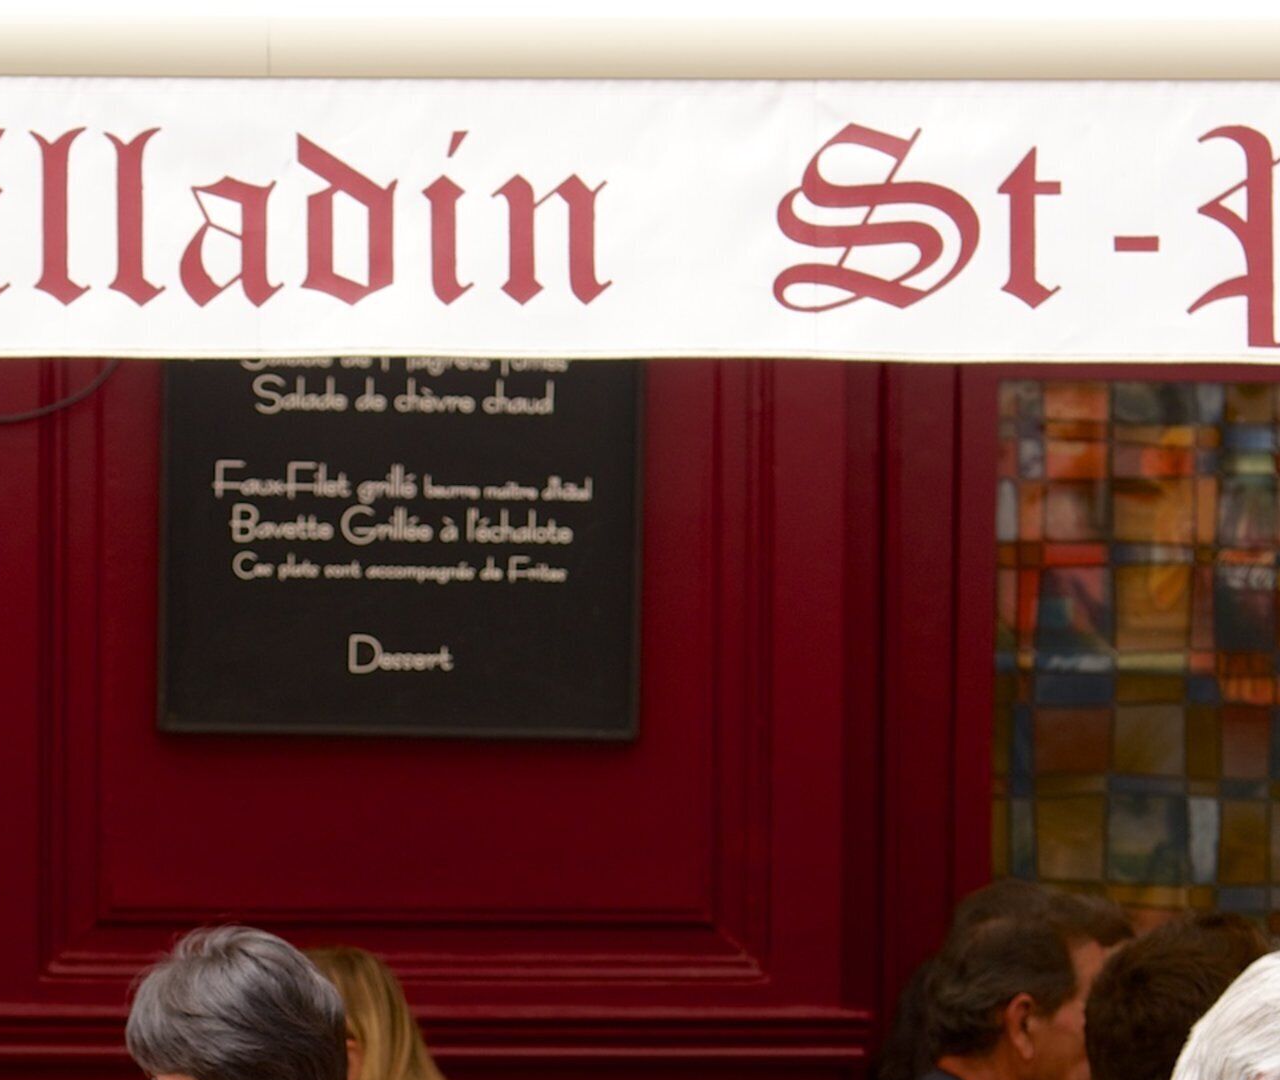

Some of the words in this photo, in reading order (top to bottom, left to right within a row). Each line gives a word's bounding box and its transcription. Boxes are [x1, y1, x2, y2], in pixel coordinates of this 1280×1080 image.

[252, 373, 349, 415] Salade
[354, 376, 388, 412] de
[392, 376, 477, 414] chèvre
[481, 378, 556, 415] chaud
[356, 462, 419, 505] grillé
[229, 503, 334, 543] Bavette
[340, 504, 434, 545] Grillée
[438, 515, 460, 543] à
[231, 550, 275, 581] Ces
[277, 551, 320, 583] plats
[323, 558, 363, 580] sont
[478, 554, 505, 582] de
[507, 554, 569, 584] Frites
[348, 633, 455, 674] Dessert
